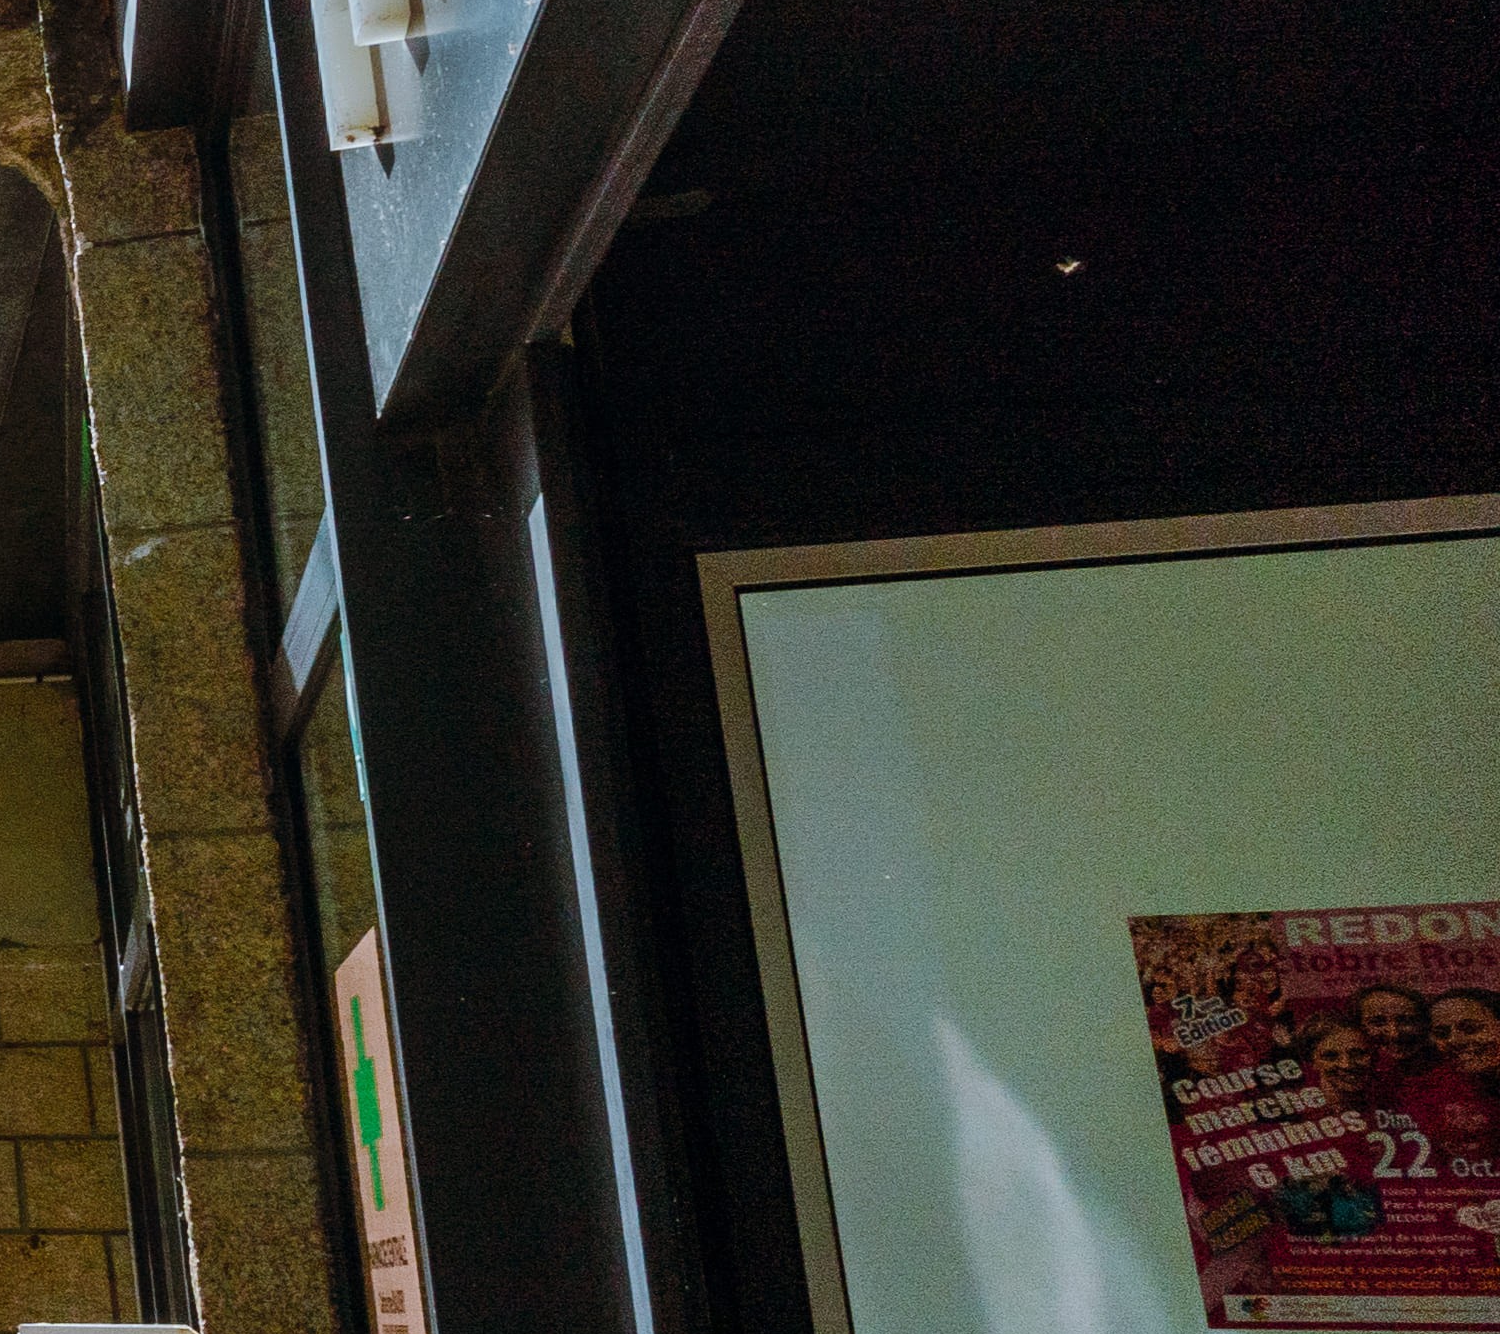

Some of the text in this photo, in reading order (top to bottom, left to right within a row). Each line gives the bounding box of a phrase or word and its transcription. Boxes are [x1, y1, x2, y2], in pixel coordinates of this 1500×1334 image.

[1177, 1010, 1244, 1046] Edition
[1172, 1058, 1304, 1105] Course
[1185, 1085, 1327, 1136] marche
[1376, 1109, 1419, 1130] Dim.
[1248, 1147, 1348, 1189] 6 km
[1366, 1130, 1439, 1179] 22
